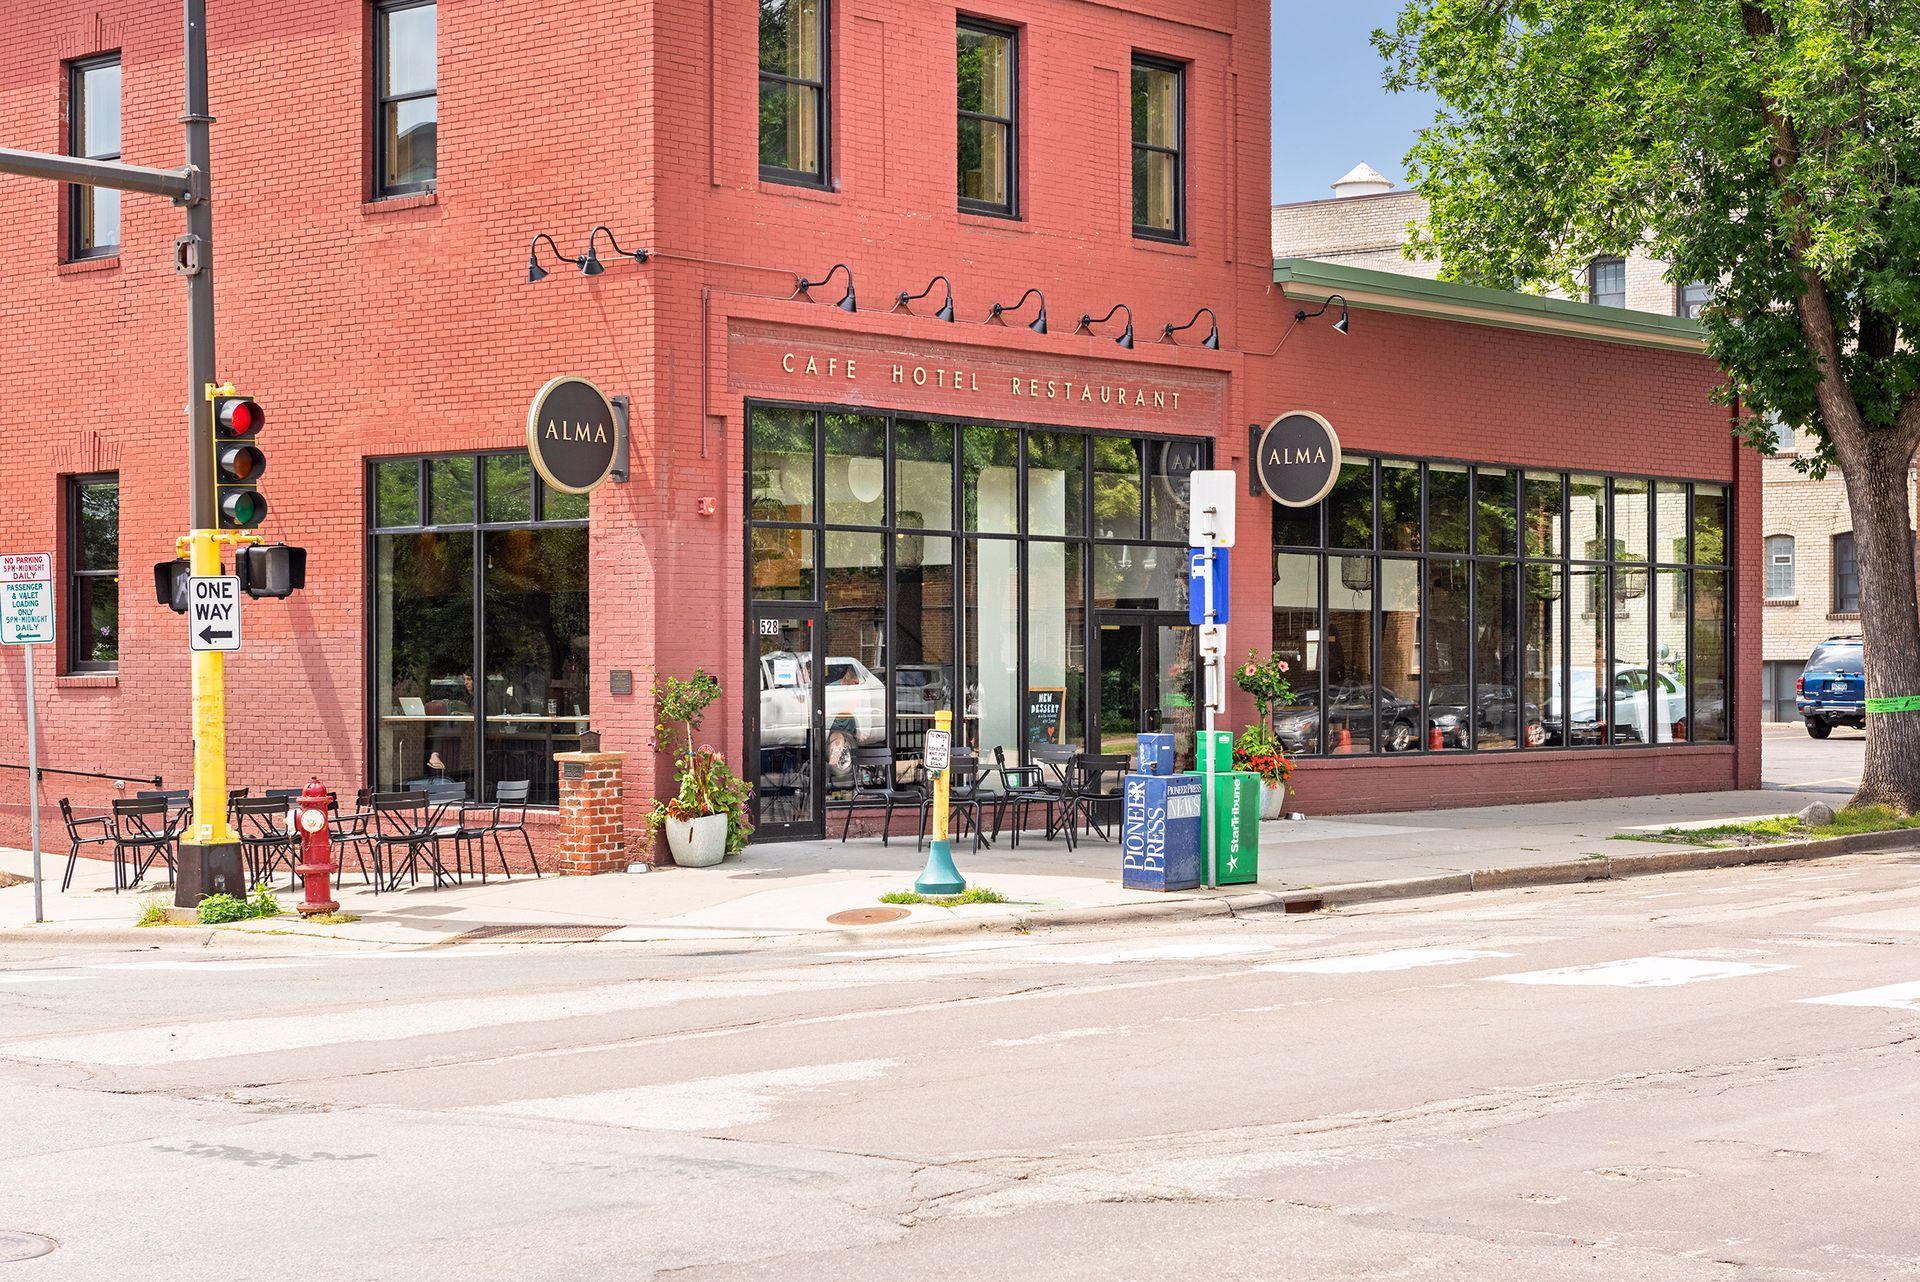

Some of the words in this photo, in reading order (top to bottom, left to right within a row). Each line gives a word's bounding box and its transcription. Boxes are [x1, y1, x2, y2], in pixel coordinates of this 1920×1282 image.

[782, 353, 856, 379] CAFE
[892, 364, 979, 391] HOTEL
[1011, 377, 1180, 410] RESTAURANT
[545, 419, 607, 443] ALMA
[1268, 446, 1327, 466] ALMA
[16, 556, 43, 564] PARKING
[3, 564, 45, 572] 5PM-MIDNIGHT
[13, 572, 37, 580] DAILY
[6, 583, 43, 591] PASSENGER
[196, 581, 233, 599] ONE
[12, 600, 39, 608] LOADING
[195, 603, 233, 621] WAY
[5, 616, 48, 624] 5PM-MIDNIGHT
[760, 620, 778, 633] 528
[15, 624, 39, 632] DAILY
[1038, 693, 1053, 703] NEW
[1031, 704, 1059, 714] DESSERT
[1168, 796, 1200, 817] NEWS
[1231, 779, 1241, 853] StarTribune
[1124, 780, 1146, 870] PIONEER
[1144, 807, 1166, 873] PRESS
